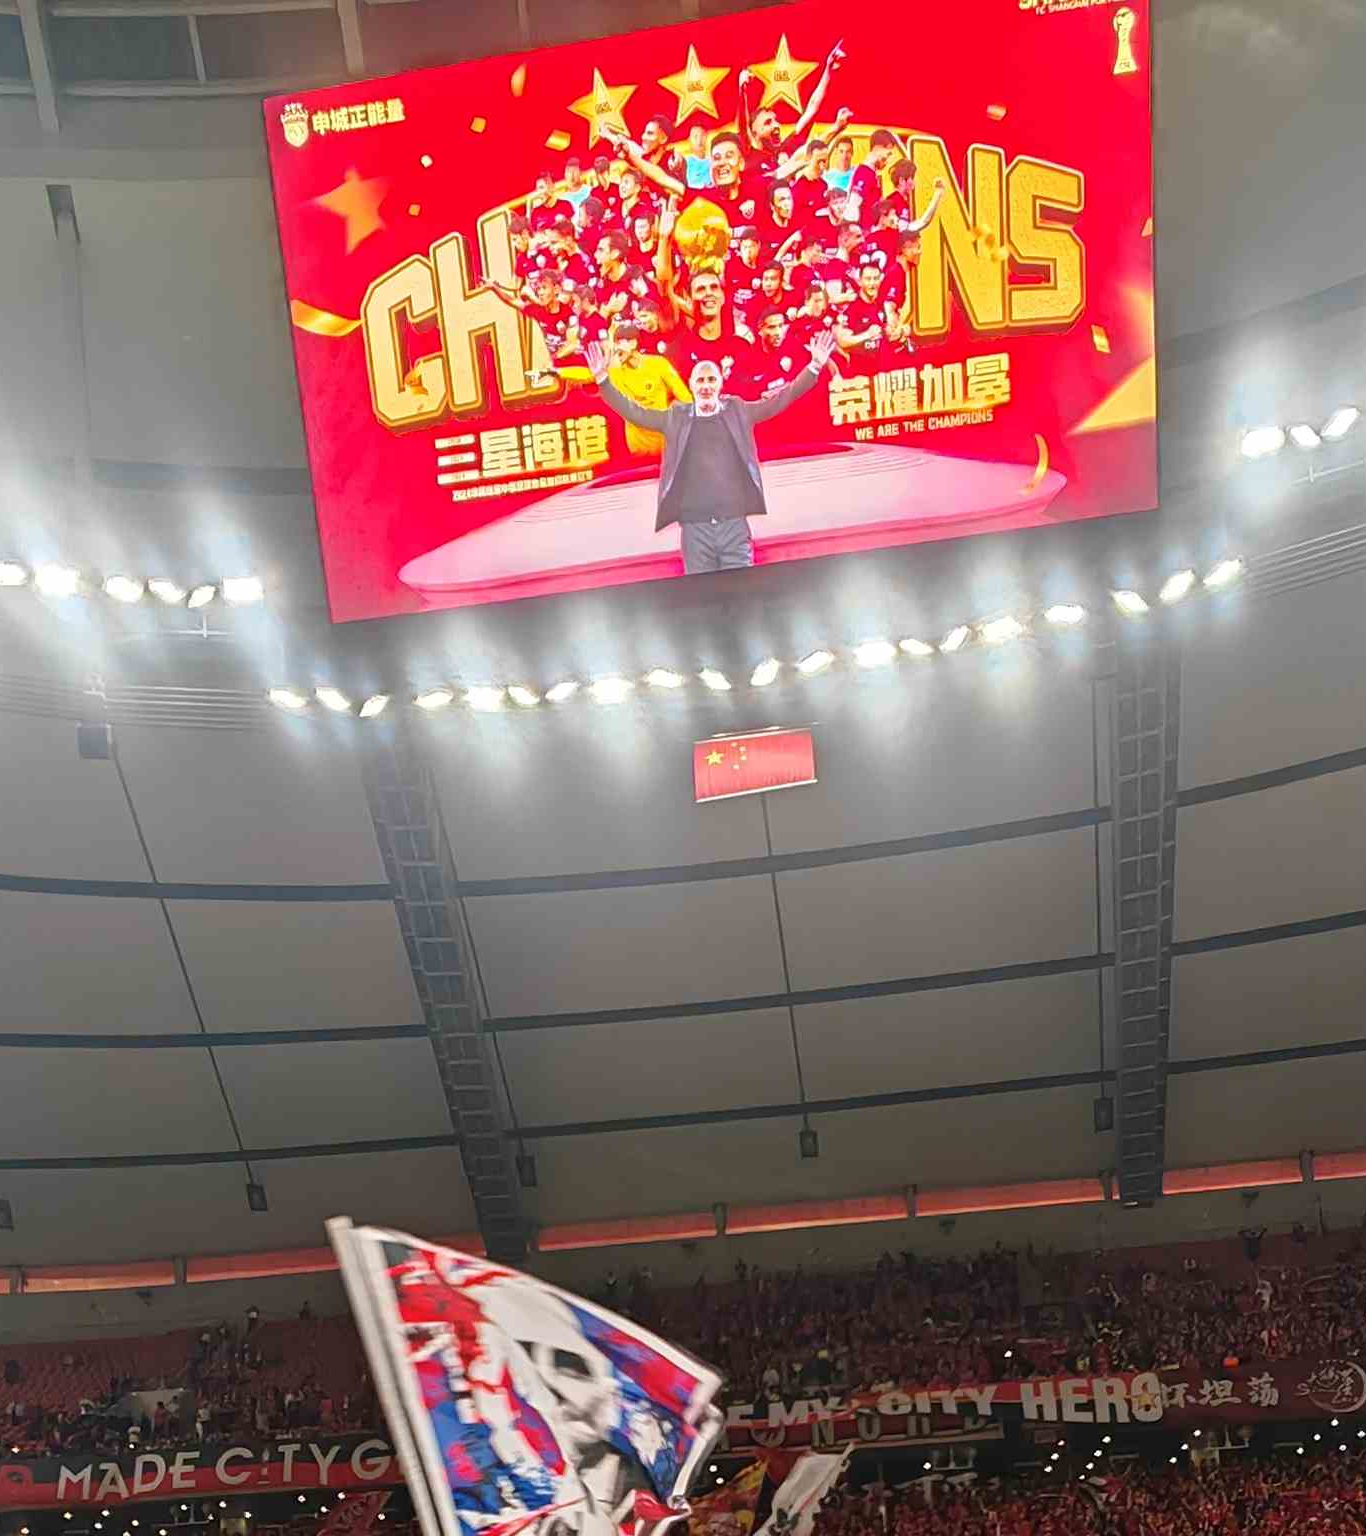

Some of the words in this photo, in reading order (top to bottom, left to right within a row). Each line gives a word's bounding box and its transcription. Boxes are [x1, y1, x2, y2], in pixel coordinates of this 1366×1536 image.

[311, 98, 406, 136] 申城正能量
[435, 415, 610, 484] 三星海港
[855, 426, 875, 440] WE
[877, 422, 900, 437] ARE
[903, 418, 925, 433] THE
[928, 409, 994, 431] CHAMPIONS
[877, 1386, 997, 1416] CITY
[1019, 1372, 1165, 1424] HERO
[57, 1451, 201, 1501] MADE
